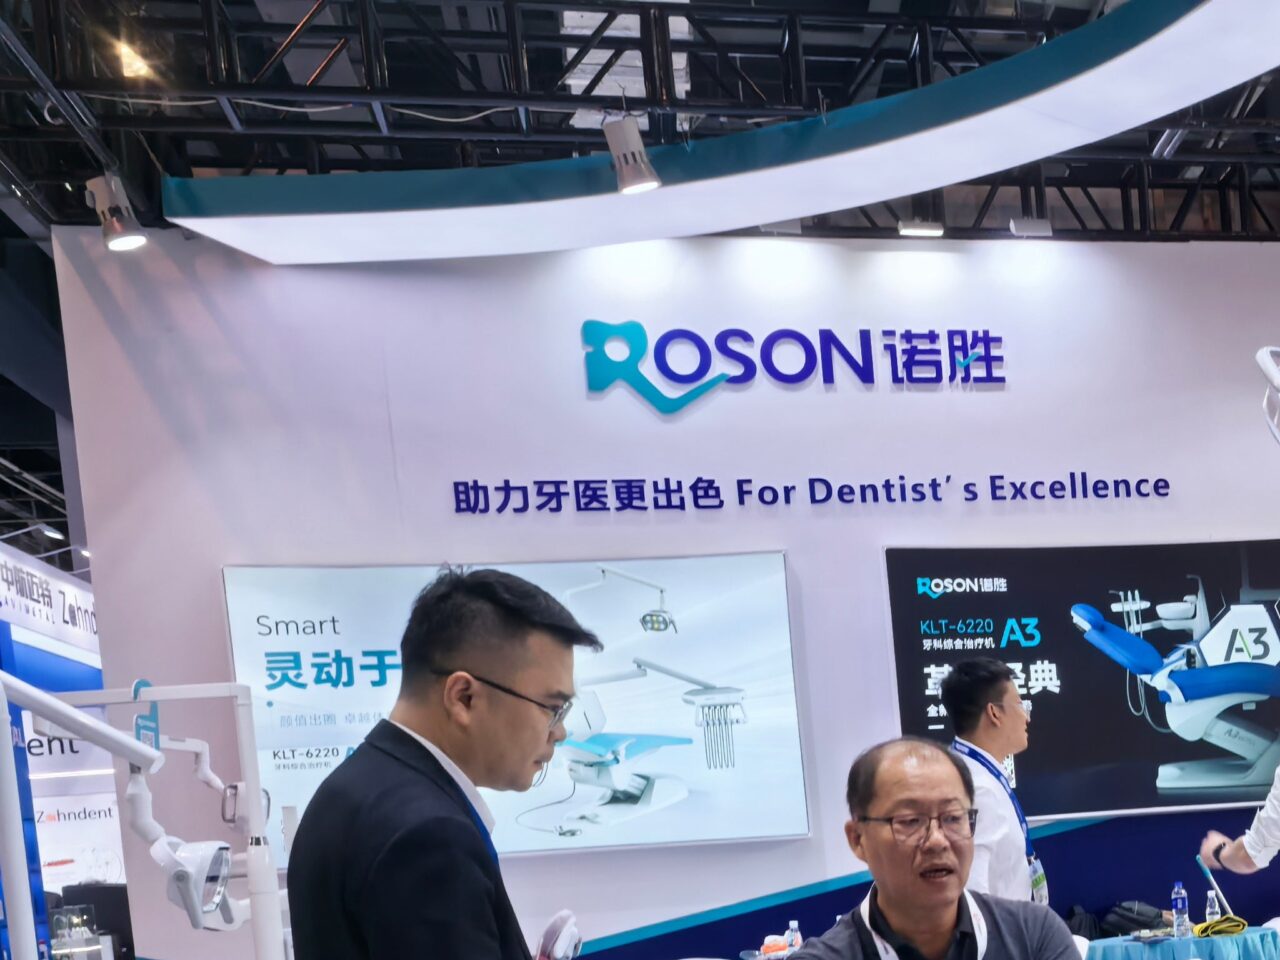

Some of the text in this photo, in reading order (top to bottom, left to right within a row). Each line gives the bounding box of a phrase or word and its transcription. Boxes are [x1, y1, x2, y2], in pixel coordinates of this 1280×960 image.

[882, 328, 1007, 385] 诺胜
[453, 477, 725, 515] 助力牙医更出色
[737, 478, 797, 506] For
[989, 472, 1171, 502] Excellence
[256, 614, 341, 637] Smart
[920, 617, 1042, 648] KLT-6220 A3
[1223, 627, 1271, 662] A3
[264, 649, 403, 692] 灵动于
[272, 747, 340, 761] KLT-6220
